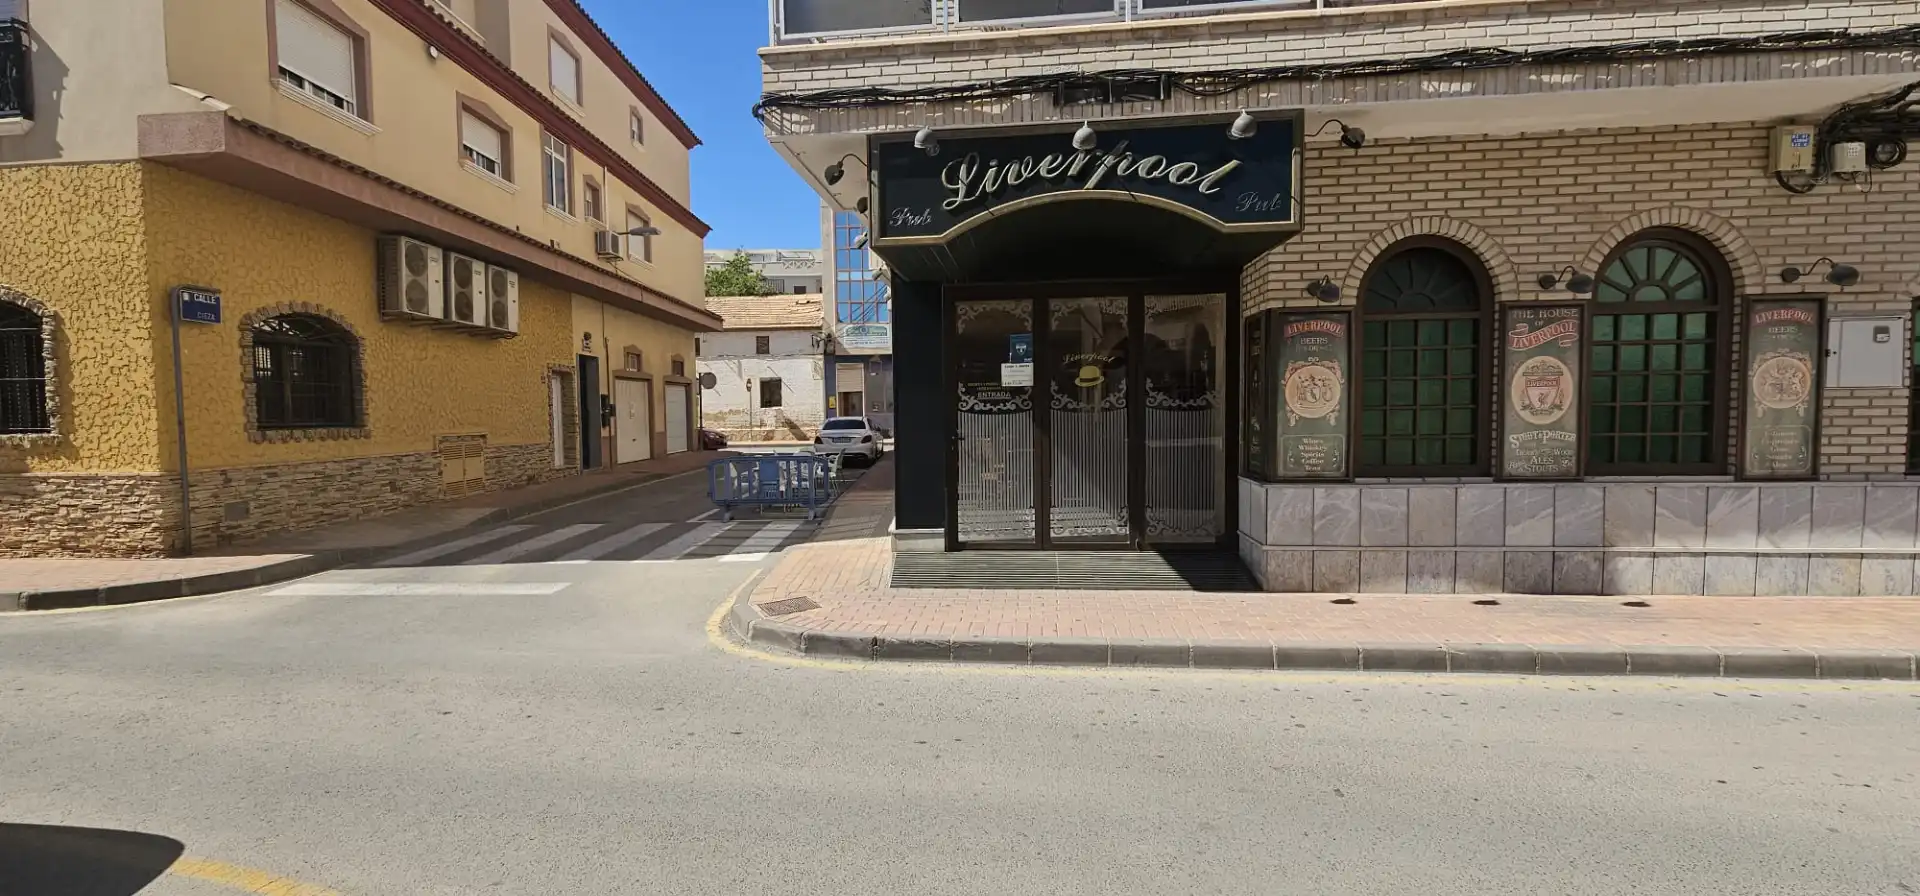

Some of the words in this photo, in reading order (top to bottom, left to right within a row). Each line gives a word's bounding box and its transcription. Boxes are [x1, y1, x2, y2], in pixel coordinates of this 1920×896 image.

[941, 139, 1243, 210] Liverpool
[1235, 191, 1282, 212] Pub
[889, 207, 933, 227] Pub
[193, 293, 217, 305] CALLE
[1511, 309, 1534, 319] THE
[1539, 308, 1578, 318] HOUSE
[1755, 309, 1813, 324] LIVERPOOL
[1287, 320, 1342, 335] LIVERPOOL
[1511, 321, 1576, 348] LIVERPOOL
[1300, 337, 1328, 345] BEERS
[1530, 455, 1554, 465] ALES
